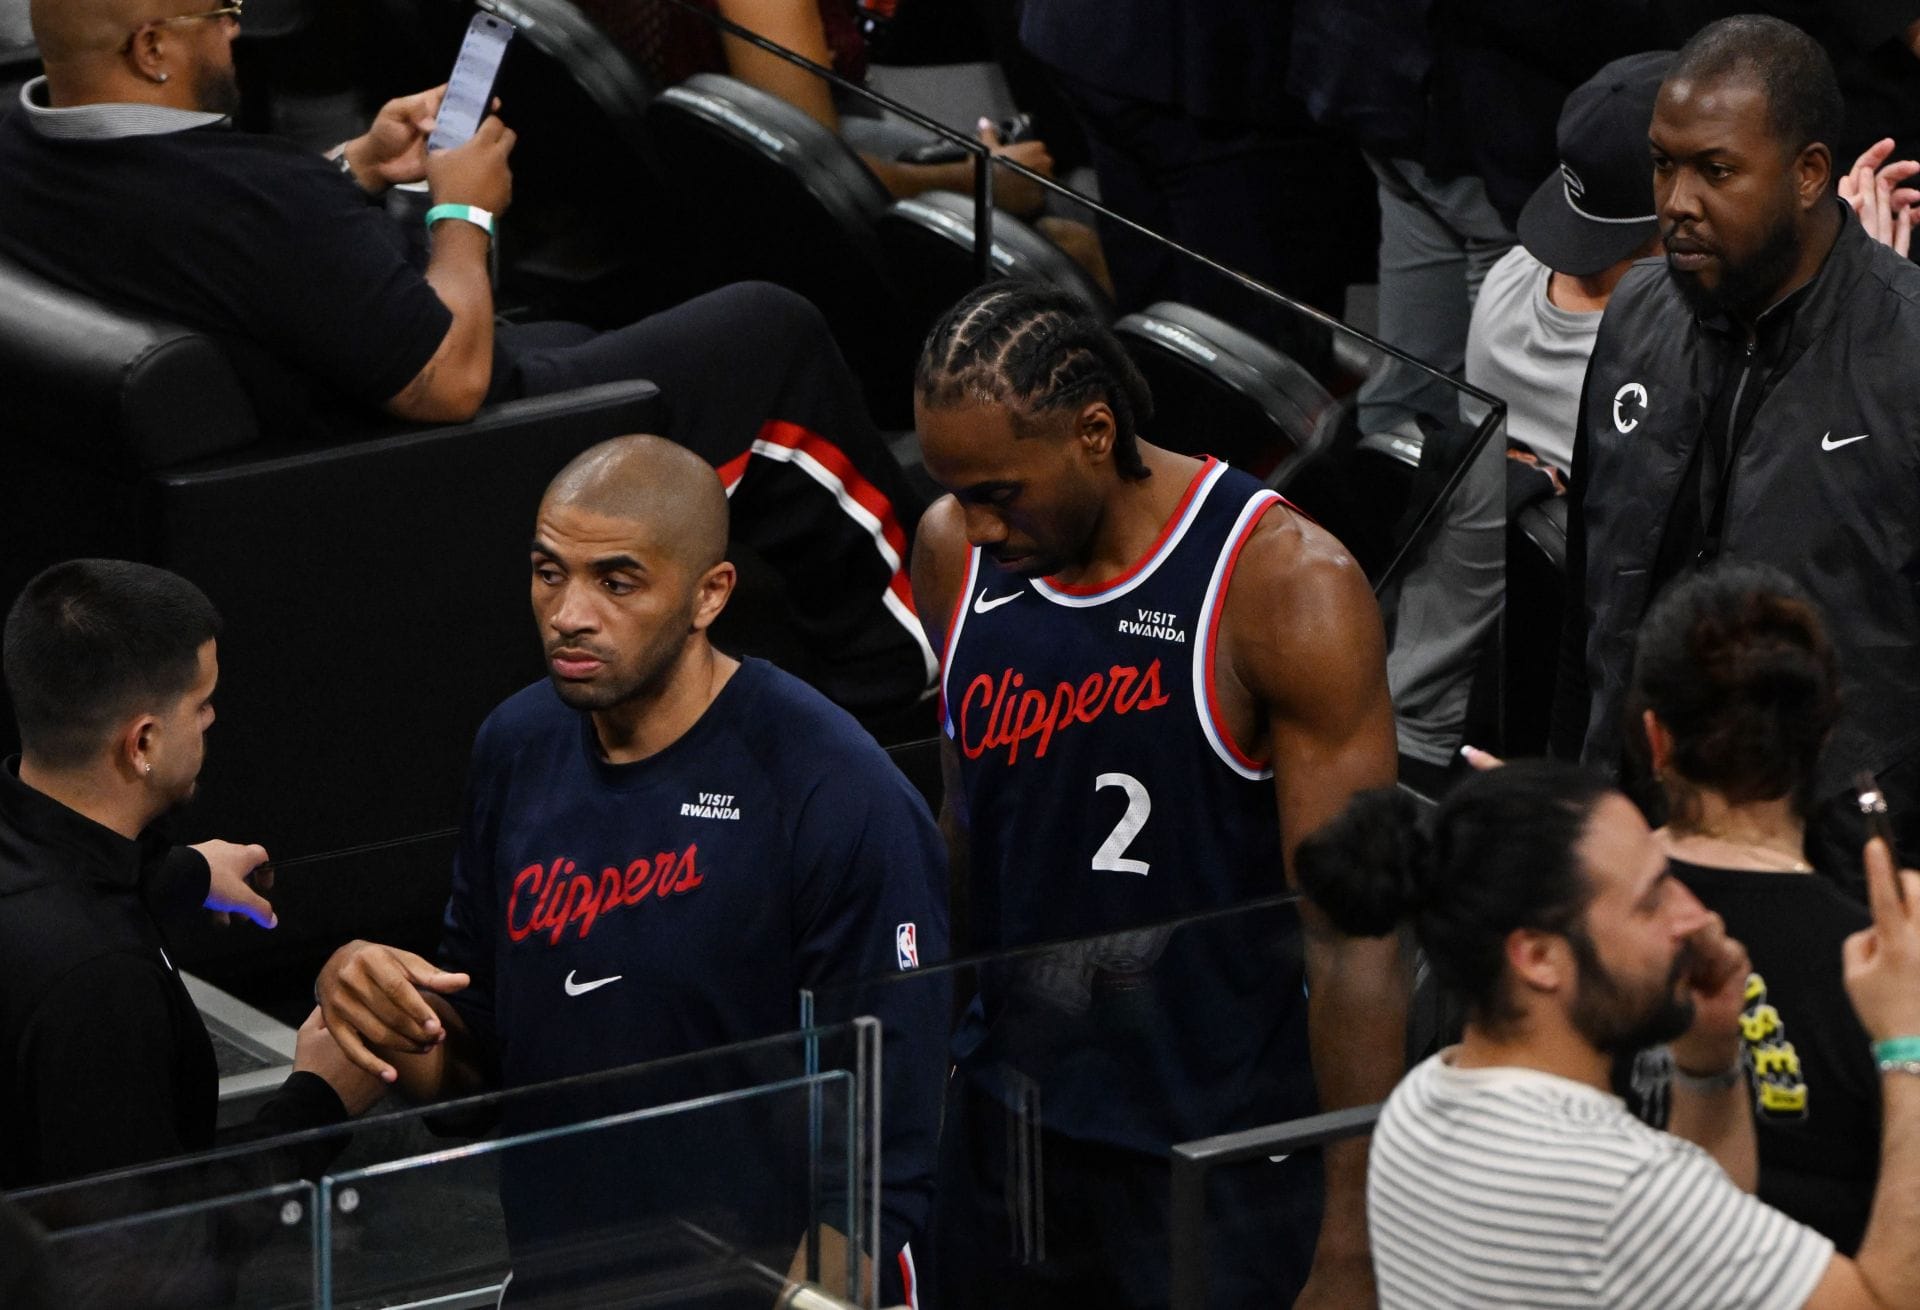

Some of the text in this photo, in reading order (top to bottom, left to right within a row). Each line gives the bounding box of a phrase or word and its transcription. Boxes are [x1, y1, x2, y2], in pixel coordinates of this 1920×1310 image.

[1138, 608, 1177, 627] VISIT
[1118, 619, 1185, 643] RWANDA
[960, 657, 1170, 766] Clippers
[680, 803, 740, 820] RWANDA
[699, 792, 735, 807] VISIT
[1091, 772, 1151, 876] 2
[507, 843, 704, 945] Clippers
